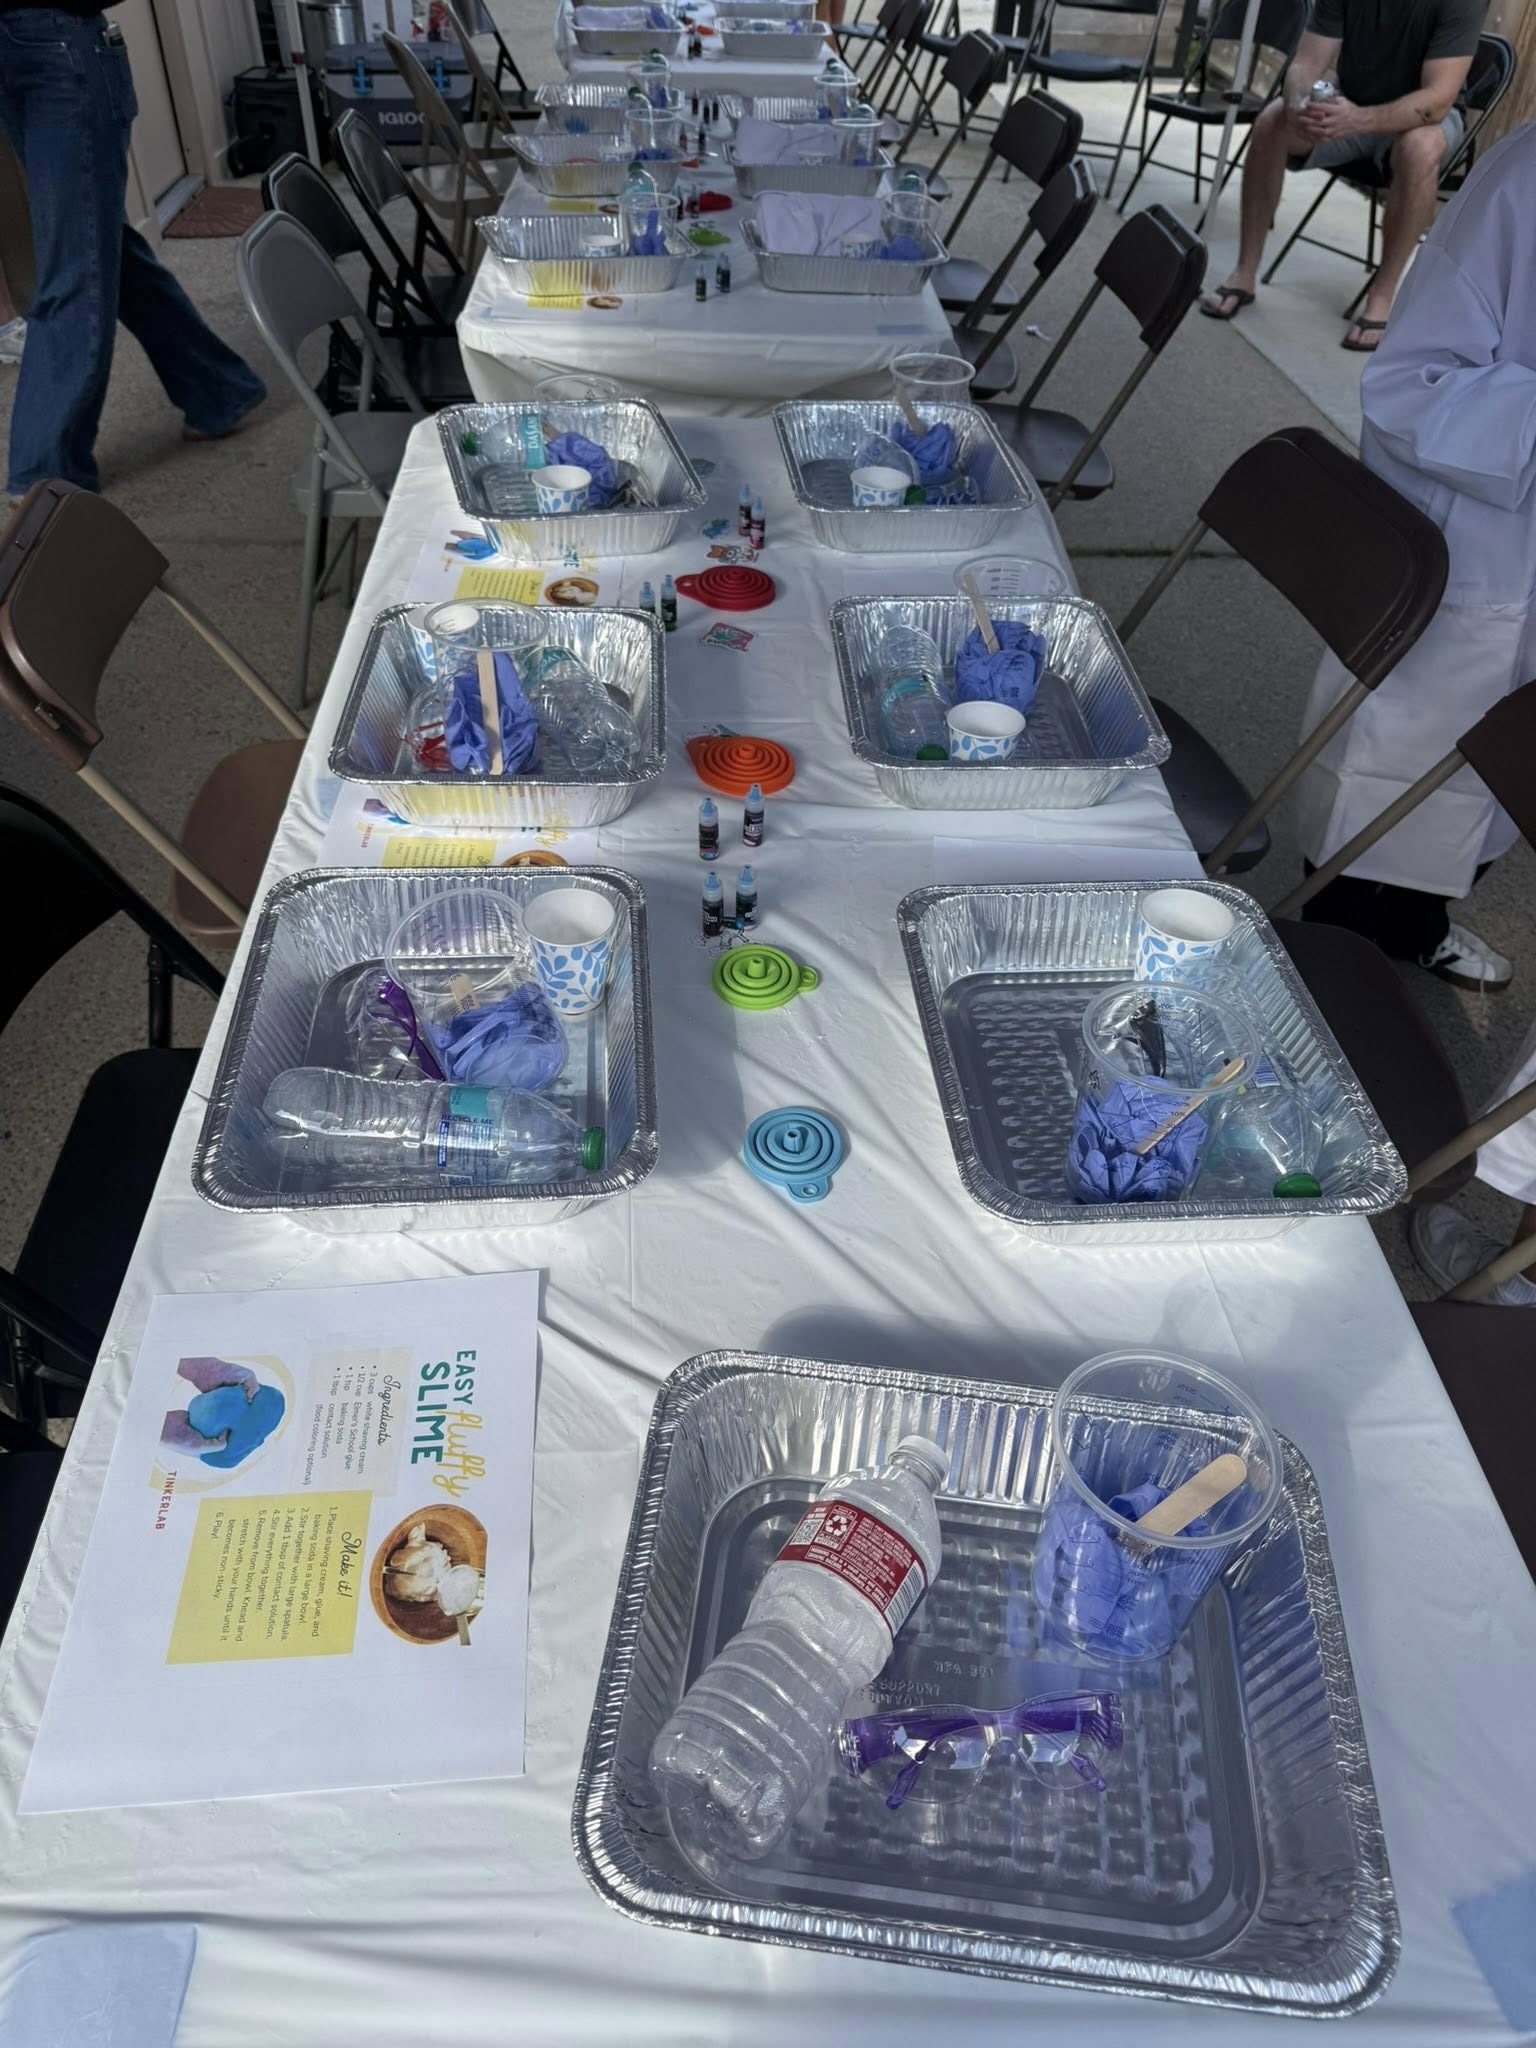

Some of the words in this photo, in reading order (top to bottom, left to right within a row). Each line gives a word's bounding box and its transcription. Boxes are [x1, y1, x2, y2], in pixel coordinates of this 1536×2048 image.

[524, 416, 541, 449] DASAN
[441, 1114, 478, 1124] RECYCLE
[480, 1118, 494, 1126] ME
[367, 1378, 376, 1395] cups
[453, 1349, 477, 1405] EASY
[354, 1384, 363, 1397] cup
[313, 1404, 323, 1422] (food
[325, 1403, 336, 1429] contact
[338, 1402, 349, 1425] baking
[350, 1402, 362, 1427] Elmer's
[364, 1401, 374, 1421] white
[377, 1375, 401, 1446] Ingredients
[411, 1361, 451, 1465] SLIME
[308, 1423, 320, 1452] coloring
[321, 1430, 332, 1459] solution
[335, 1427, 345, 1445] soda
[347, 1428, 358, 1453] School
[359, 1422, 371, 1450] shaving
[344, 1454, 354, 1470] glue
[357, 1451, 367, 1474] cream
[432, 1409, 487, 1498] fluffy
[303, 1453, 316, 1486] optional)
[155, 1471, 178, 1530] TINKERLAB
[223, 1519, 236, 1554] becomes
[239, 1518, 250, 1546] stretch
[310, 1514, 322, 1540] baking
[236, 1547, 245, 1565] with
[261, 1532, 276, 1575] everything
[278, 1541, 290, 1560] tbsp
[292, 1530, 305, 1565] together
[307, 1542, 319, 1561] soda
[320, 1536, 332, 1567] shaving
[339, 1531, 362, 1577] Make
[249, 1551, 259, 1571] from
[278, 1561, 286, 1570] of
[306, 1563, 315, 1571] in
[231, 1566, 241, 1585] your
[245, 1572, 256, 1595] bowl.
[290, 1566, 300, 1584] with
[317, 1569, 327, 1597] cream,
[226, 1587, 237, 1613] hands
[256, 1576, 270, 1614] together.
[272, 1572, 285, 1606] contact
[285, 1586, 297, 1607] large
[301, 1579, 312, 1601] large
[337, 1580, 353, 1599] it!
[238, 1596, 251, 1623] Knead
[299, 1603, 309, 1625] bowl.
[222, 1614, 232, 1633] until
[235, 1625, 244, 1642] and
[311, 1620, 320, 1637] and
